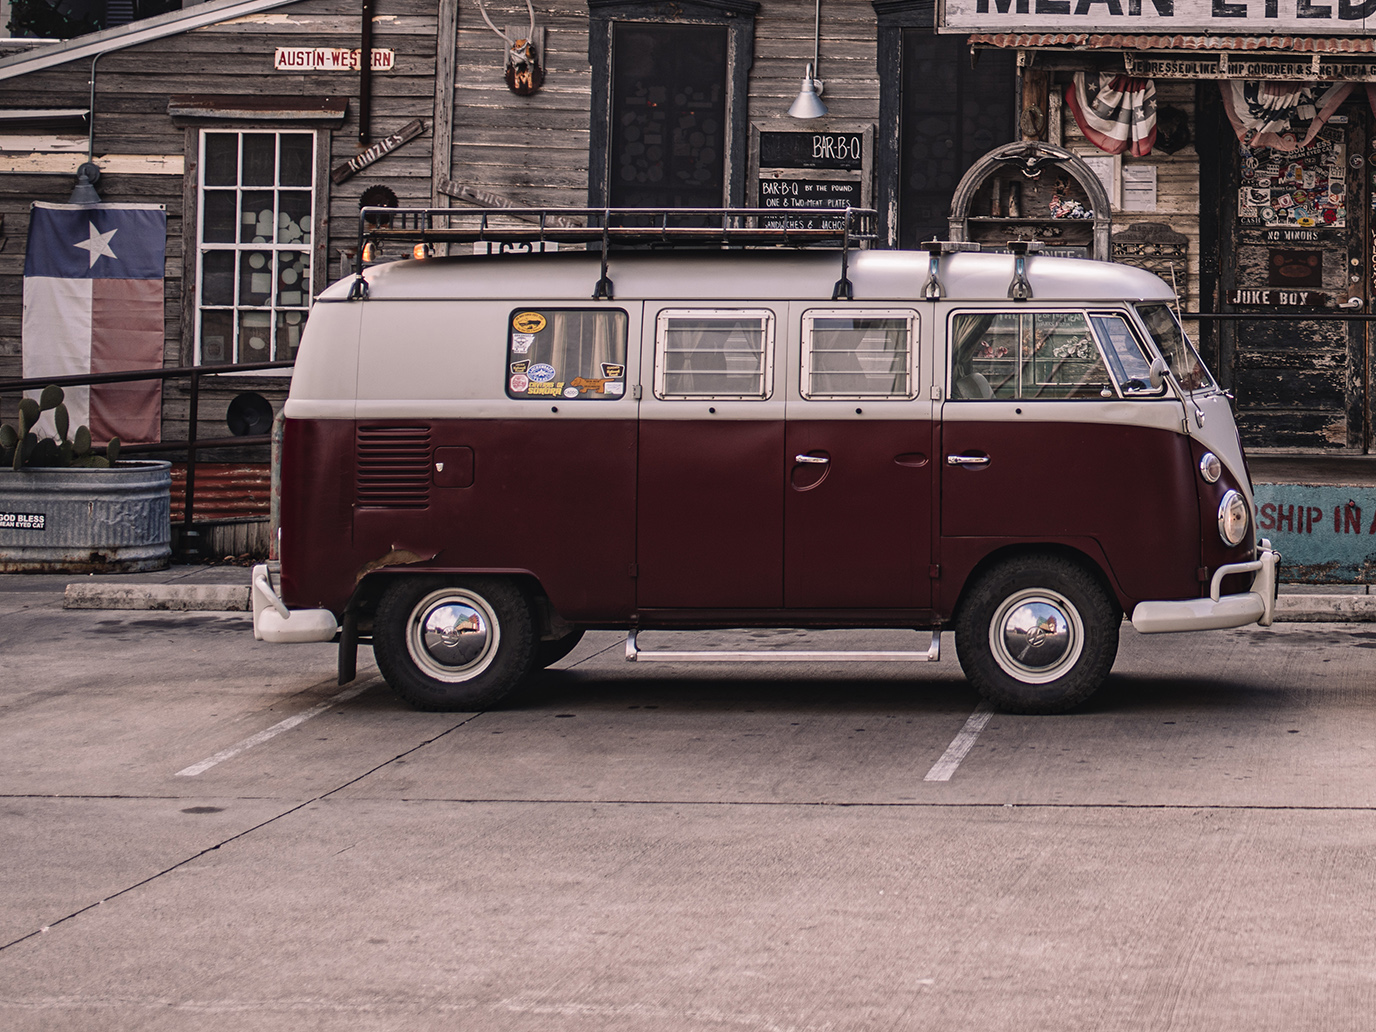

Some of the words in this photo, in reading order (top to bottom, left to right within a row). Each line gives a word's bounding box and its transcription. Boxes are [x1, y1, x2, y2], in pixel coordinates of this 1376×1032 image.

[278, 50, 391, 67] AUSTIN-WESRN
[1193, 62, 1217, 74] LIKE
[1305, 64, 1332, 76] SNG
[347, 132, 404, 173] KOOZIES
[812, 135, 861, 160] BAR-B-Q
[762, 181, 799, 196] BAR-B-Q
[804, 184, 813, 192] BY
[816, 184, 827, 192] THE
[831, 184, 853, 192] POUND
[766, 198, 780, 207] ONE
[827, 199, 851, 208] PLATES
[764, 220, 805, 229] ANDWCHES
[1267, 231, 1280, 240] NO
[1284, 231, 1319, 241] MINORS
[1233, 291, 1271, 305] JUKE
[1280, 291, 1309, 305] BOX
[527, 387, 563, 397] SONORA
[17, 514, 45, 523] BLESS
[1254, 502, 1323, 535] SHIP
[1334, 504, 1362, 535] IN
